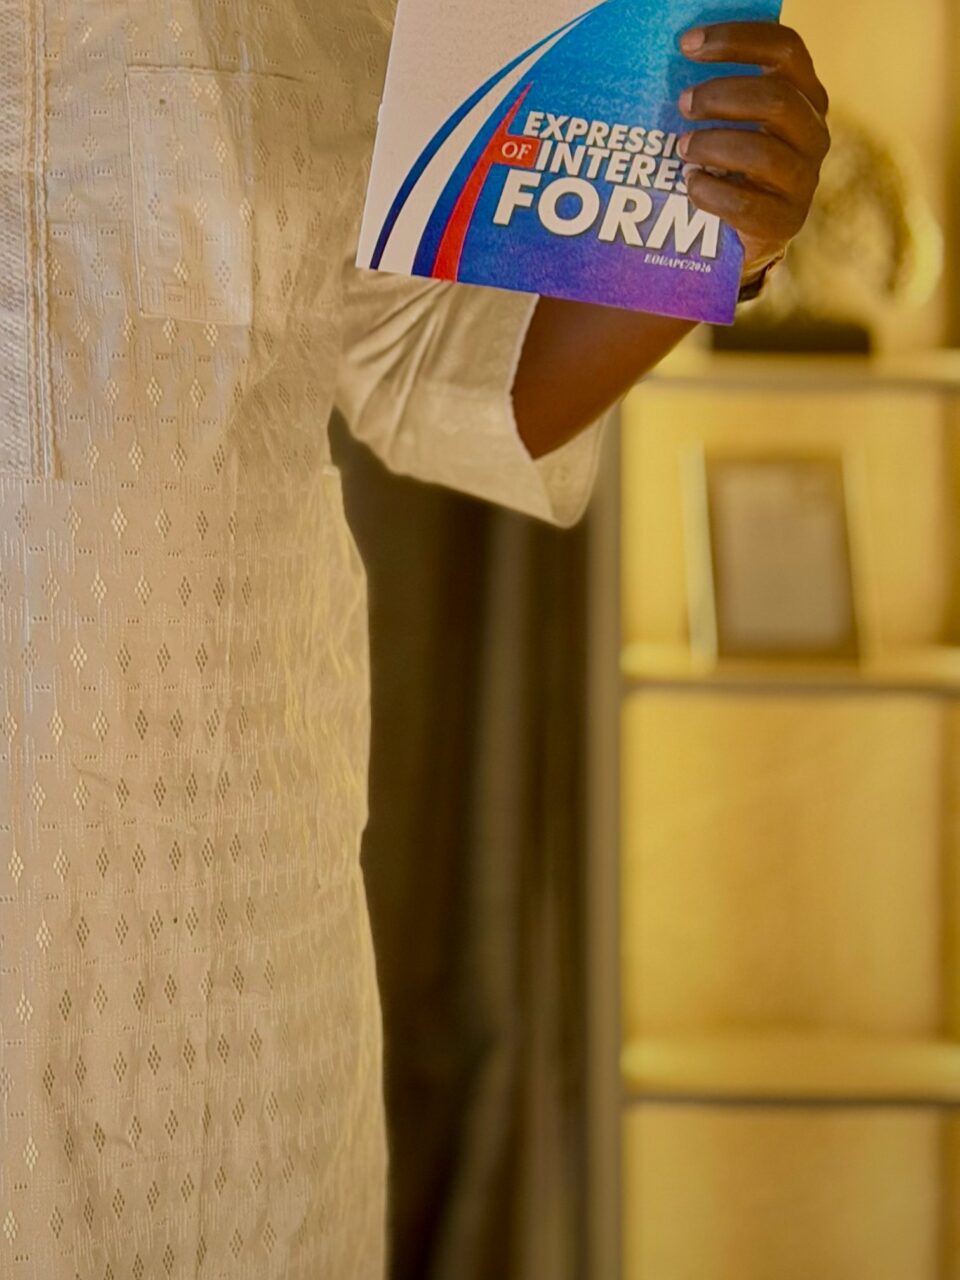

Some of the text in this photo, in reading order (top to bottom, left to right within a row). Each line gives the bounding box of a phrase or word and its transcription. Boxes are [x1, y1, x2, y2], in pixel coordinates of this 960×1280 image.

[501, 140, 532, 162] OF
[523, 111, 684, 158] EXPRESSI
[493, 168, 721, 259] FORM
